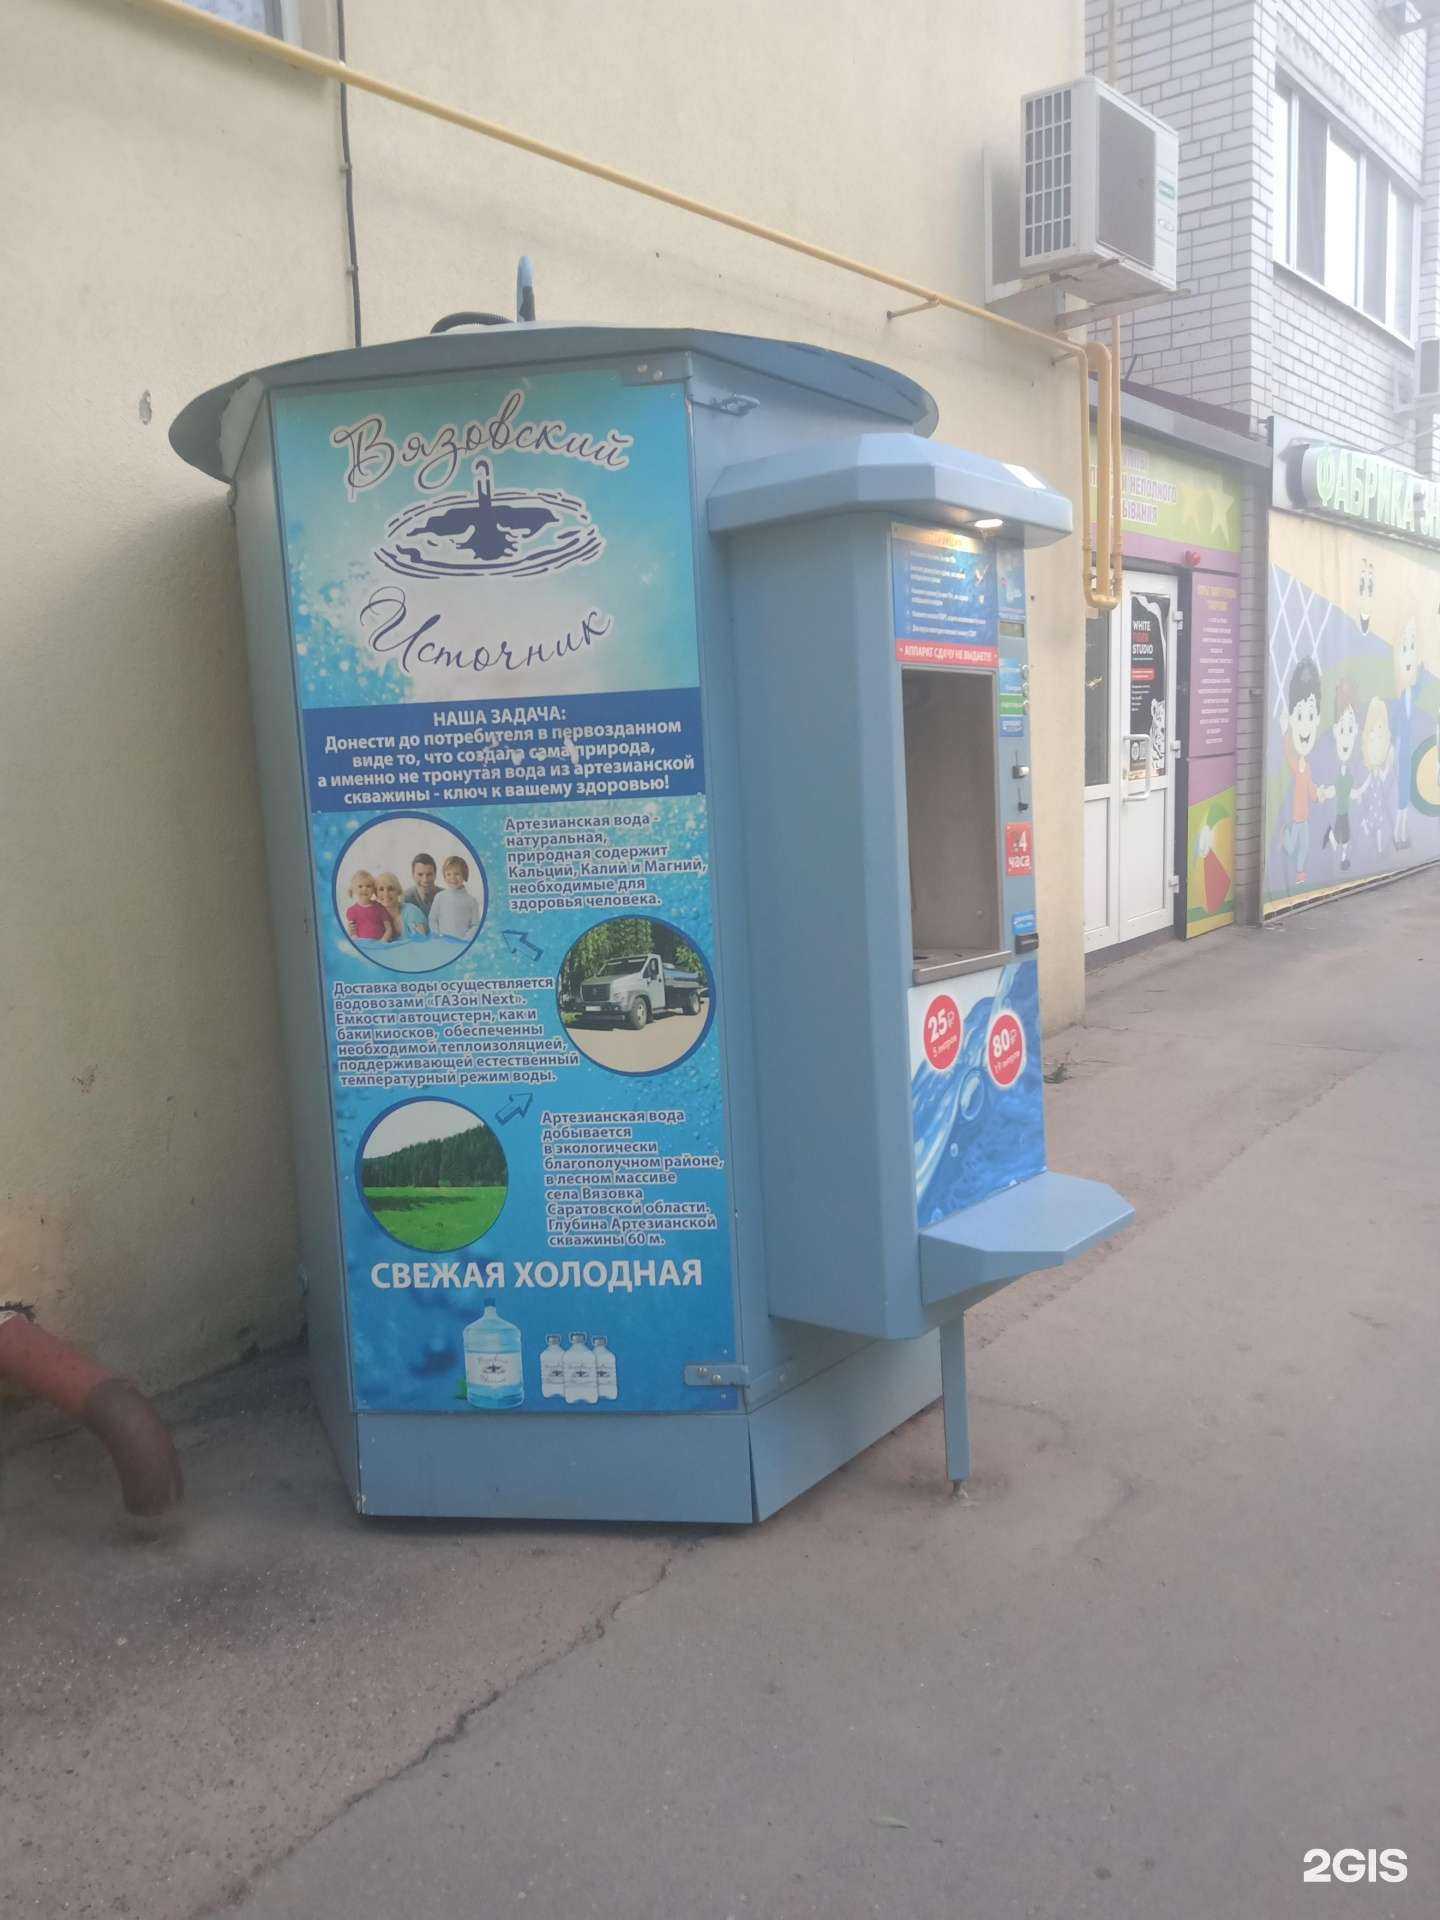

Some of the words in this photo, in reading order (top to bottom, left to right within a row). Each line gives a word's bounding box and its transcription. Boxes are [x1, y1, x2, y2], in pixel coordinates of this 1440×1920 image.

[332, 391, 633, 502] Вязовский
[360, 586, 613, 673] Источник
[1133, 620, 1151, 632] WHITE
[433, 709, 487, 726] НАША
[491, 706, 566, 726] ЗАДАЧА:
[325, 734, 395, 753] Донести
[399, 734, 420, 749] до
[424, 728, 534, 749] потребителя
[538, 728, 548, 740] в
[552, 721, 682, 741] первозданном
[352, 754, 394, 769] виде
[397, 753, 421, 767] то,
[424, 752, 453, 764] что
[529, 746, 571, 759] сама
[574, 741, 655, 759] природа,
[318, 776, 327, 787] а
[331, 773, 395, 787] именно
[399, 772, 419, 783] не
[422, 768, 501, 785] тронутая
[505, 766, 546, 781] вода
[550, 764, 570, 777] из
[574, 755, 695, 777] артезианской
[344, 790, 431, 804] скважины
[443, 786, 487, 799] ключ
[492, 786, 501, 798] к
[505, 782, 572, 798] вашему
[576, 774, 669, 795] здоровью!
[506, 817, 610, 833] Артезианская
[614, 814, 650, 827] вода
[506, 833, 608, 848] натуральная,
[508, 849, 591, 864] природная
[595, 845, 668, 860] содержит
[1008, 855, 1031, 869] часа
[509, 864, 578, 878] Кальций,
[581, 863, 628, 875] Калий
[631, 863, 640, 874] и
[644, 859, 707, 874] Магний,
[510, 880, 614, 894] необходимые
[618, 879, 645, 891] для
[511, 896, 584, 911] здоровья
[586, 894, 661, 906] человека.
[334, 983, 398, 996] Доставка
[401, 983, 437, 994] воды
[441, 978, 553, 993] осуществляется
[335, 998, 424, 1011] водовозами
[336, 1013, 395, 1025] Емкости
[400, 1011, 496, 1024] автоцистерн,
[499, 1009, 525, 1020] как
[527, 1011, 536, 1020] и
[337, 1028, 372, 1040] баки
[375, 1028, 438, 1040] киосков,
[445, 1025, 543, 1037] обеспеченны
[339, 1042, 437, 1056] необходимой
[440, 1038, 567, 1053] теплоизоляцией,
[340, 1056, 473, 1072] поддерживающей
[477, 1053, 579, 1067] естественный
[341, 1072, 456, 1087] температурный
[460, 1073, 510, 1085] режим
[513, 1071, 556, 1083] воды.
[543, 1111, 645, 1126] Артезианская
[649, 1110, 685, 1122] вода
[543, 1126, 632, 1141] добывается
[544, 1145, 553, 1154] в
[556, 1142, 657, 1156] экологически
[545, 1157, 661, 1171] благополучном
[664, 1154, 723, 1169] районе,
[546, 1176, 554, 1184] в
[557, 1174, 612, 1184] лесном
[615, 1172, 676, 1183] массиве
[547, 1190, 579, 1200] села
[582, 1187, 643, 1199] Вязовка
[547, 1202, 642, 1216] Саратовской
[645, 1201, 710, 1214] области.
[549, 1218, 608, 1233] Глубина
[611, 1215, 716, 1231] Артезианской
[549, 1236, 625, 1246] скважины
[628, 1233, 645, 1244] 60
[649, 1234, 666, 1244] м.
[371, 1262, 505, 1289] СВЕЖАЯ
[514, 1259, 702, 1293] ХОЛОДНАЯ
